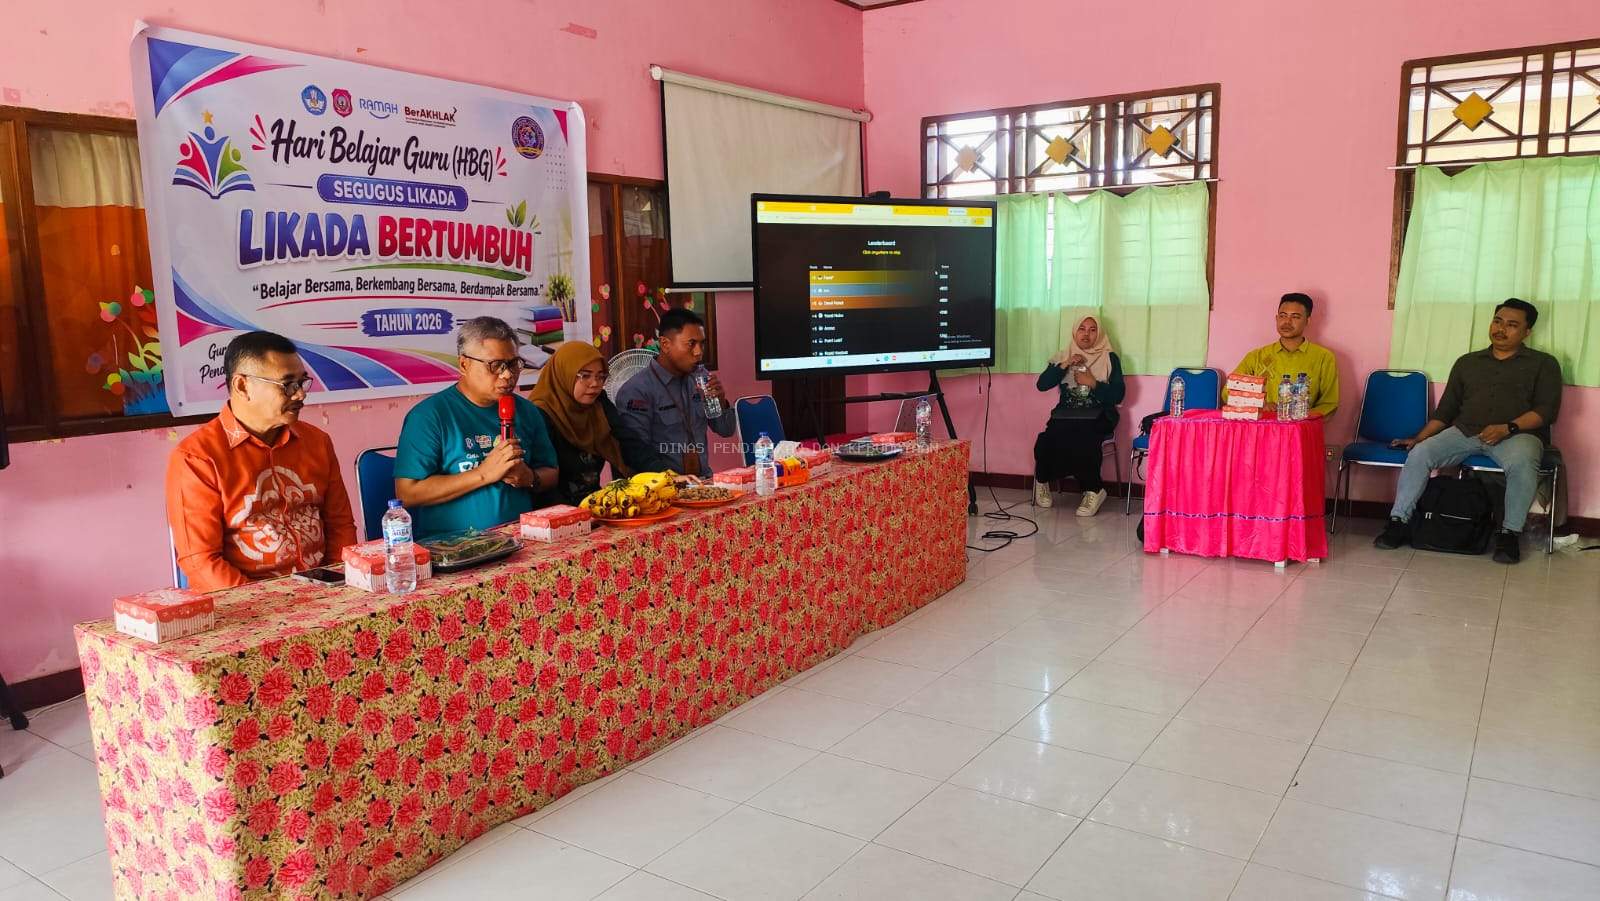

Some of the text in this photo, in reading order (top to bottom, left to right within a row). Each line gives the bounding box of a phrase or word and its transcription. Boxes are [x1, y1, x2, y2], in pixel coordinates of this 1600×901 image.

[359, 98, 399, 114] RAMAH
[404, 105, 457, 123] BerAKHLAK
[271, 118, 494, 182] Hari Belajar Guru (HBG)
[334, 180, 457, 206] SEGUGUS LIKADA
[239, 209, 533, 273] LIKADA BERTUMBUH
[252, 280, 302, 299] “Belajar
[304, 277, 353, 295] Bersama,
[356, 276, 415, 294] Berkembang
[417, 279, 458, 294] Bersama,
[460, 280, 506, 298] Berdampak
[374, 312, 442, 332] TAHUN 2026
[208, 343, 227, 361] Gur
